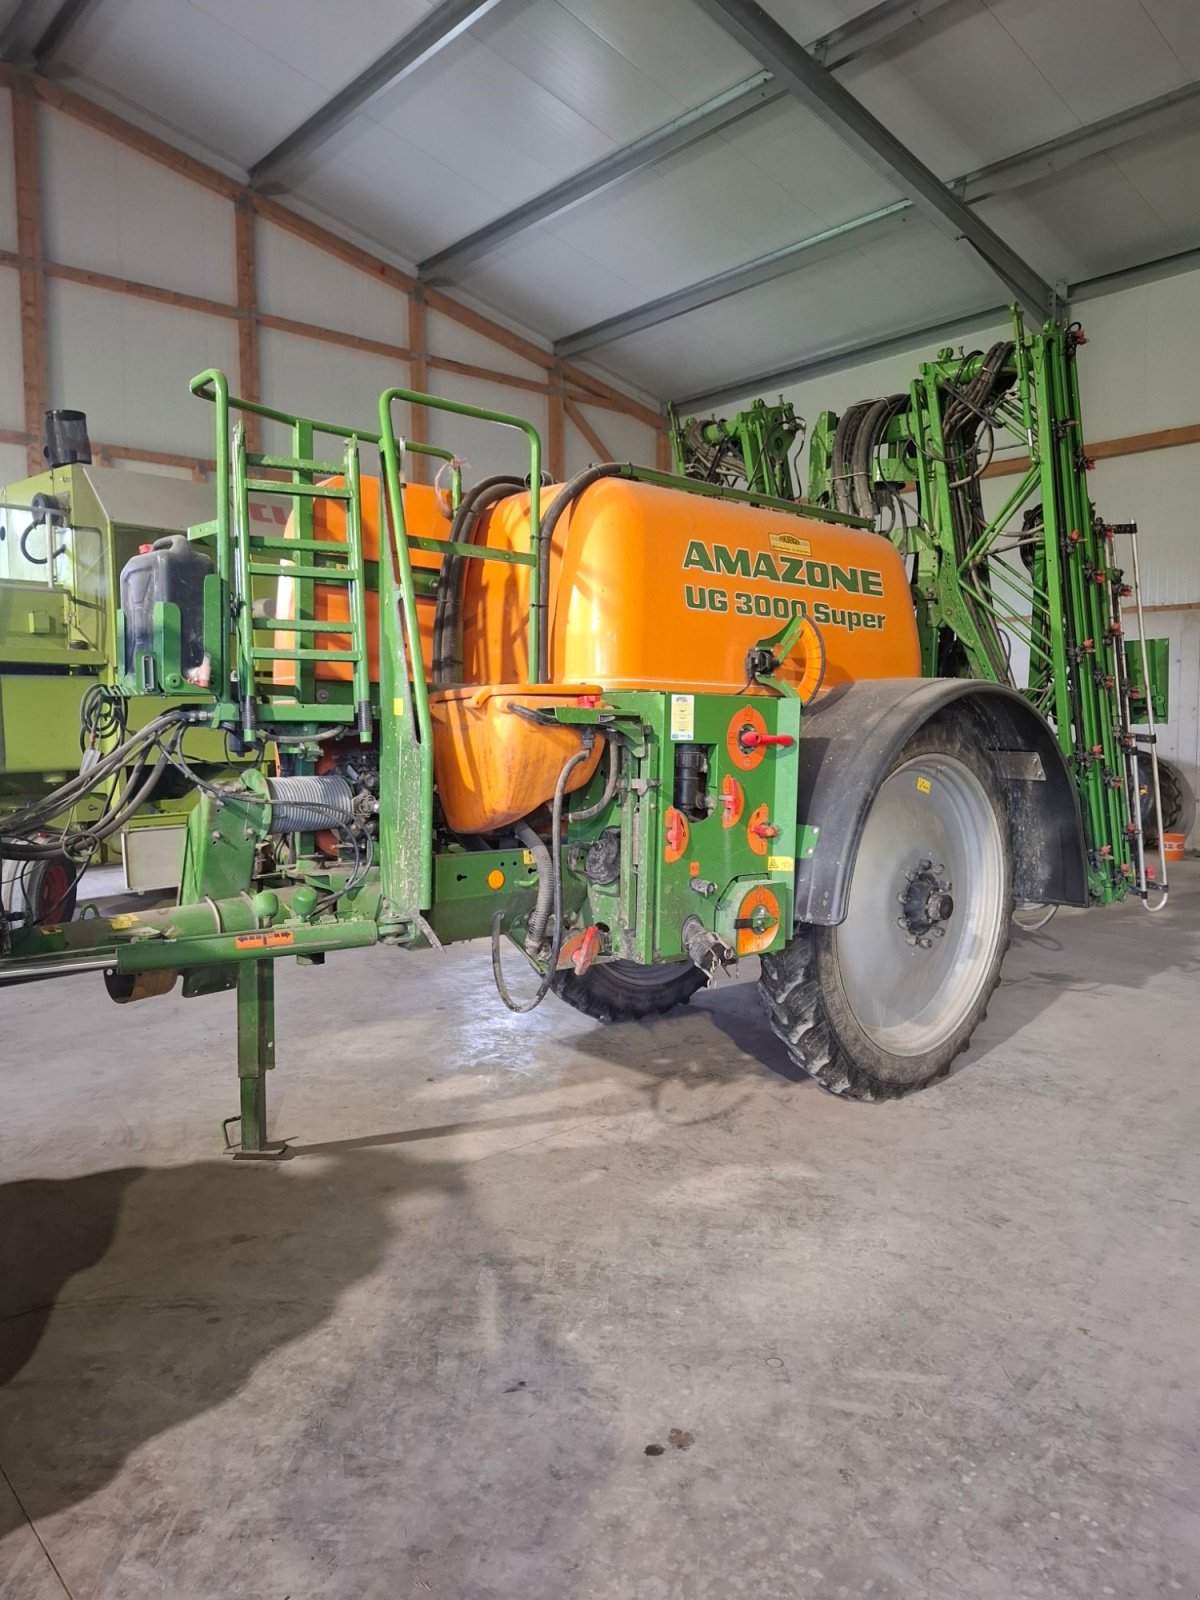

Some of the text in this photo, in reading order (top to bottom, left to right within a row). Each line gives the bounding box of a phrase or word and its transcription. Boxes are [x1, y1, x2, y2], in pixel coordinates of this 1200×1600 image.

[683, 540, 884, 597] AMAZONE
[685, 585, 886, 632] UG 3000 Super
